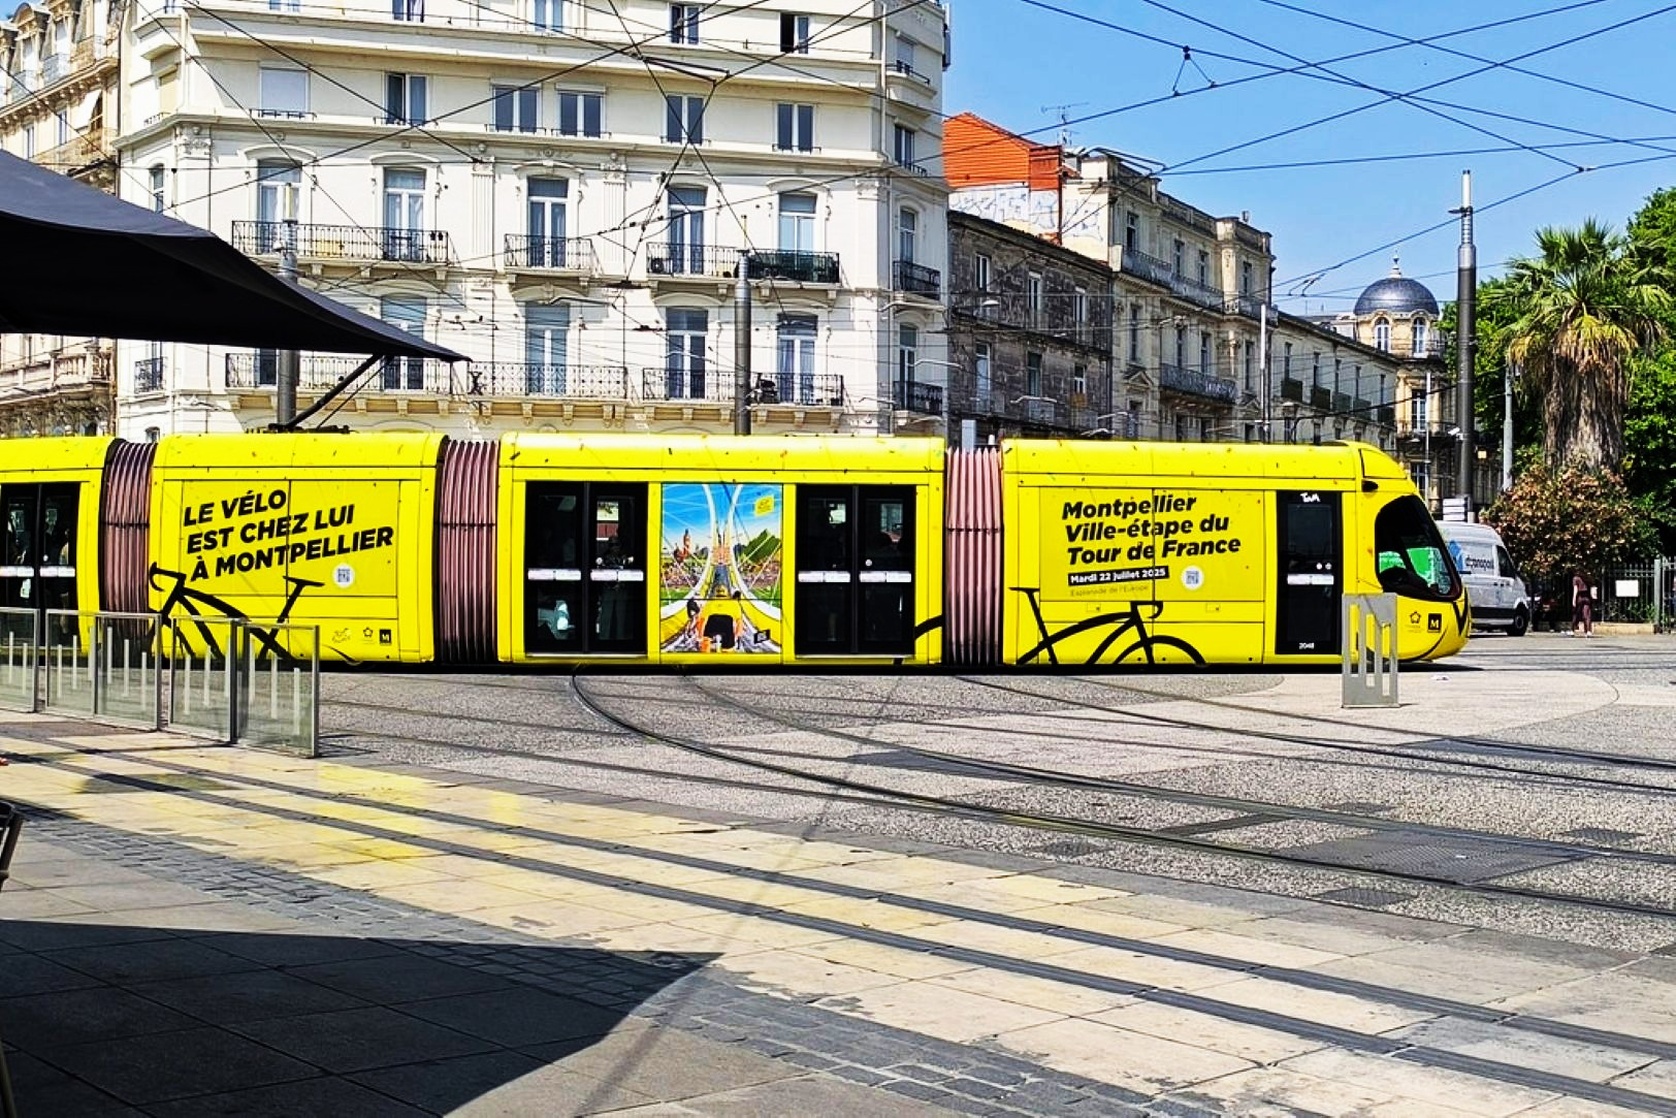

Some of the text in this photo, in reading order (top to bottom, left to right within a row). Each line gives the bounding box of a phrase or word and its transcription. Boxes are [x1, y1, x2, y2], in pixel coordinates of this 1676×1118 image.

[183, 489, 287, 527] LE VÉLO
[1062, 494, 1197, 520] Montpellier
[187, 504, 355, 554] EST CHEZ LUI
[1065, 514, 1229, 543] Ville-étape du
[190, 526, 394, 582] À MONTPELLIER
[1067, 538, 1241, 565] Tour de France
[1070, 568, 1166, 583] Mardi 22 juillet 2025
